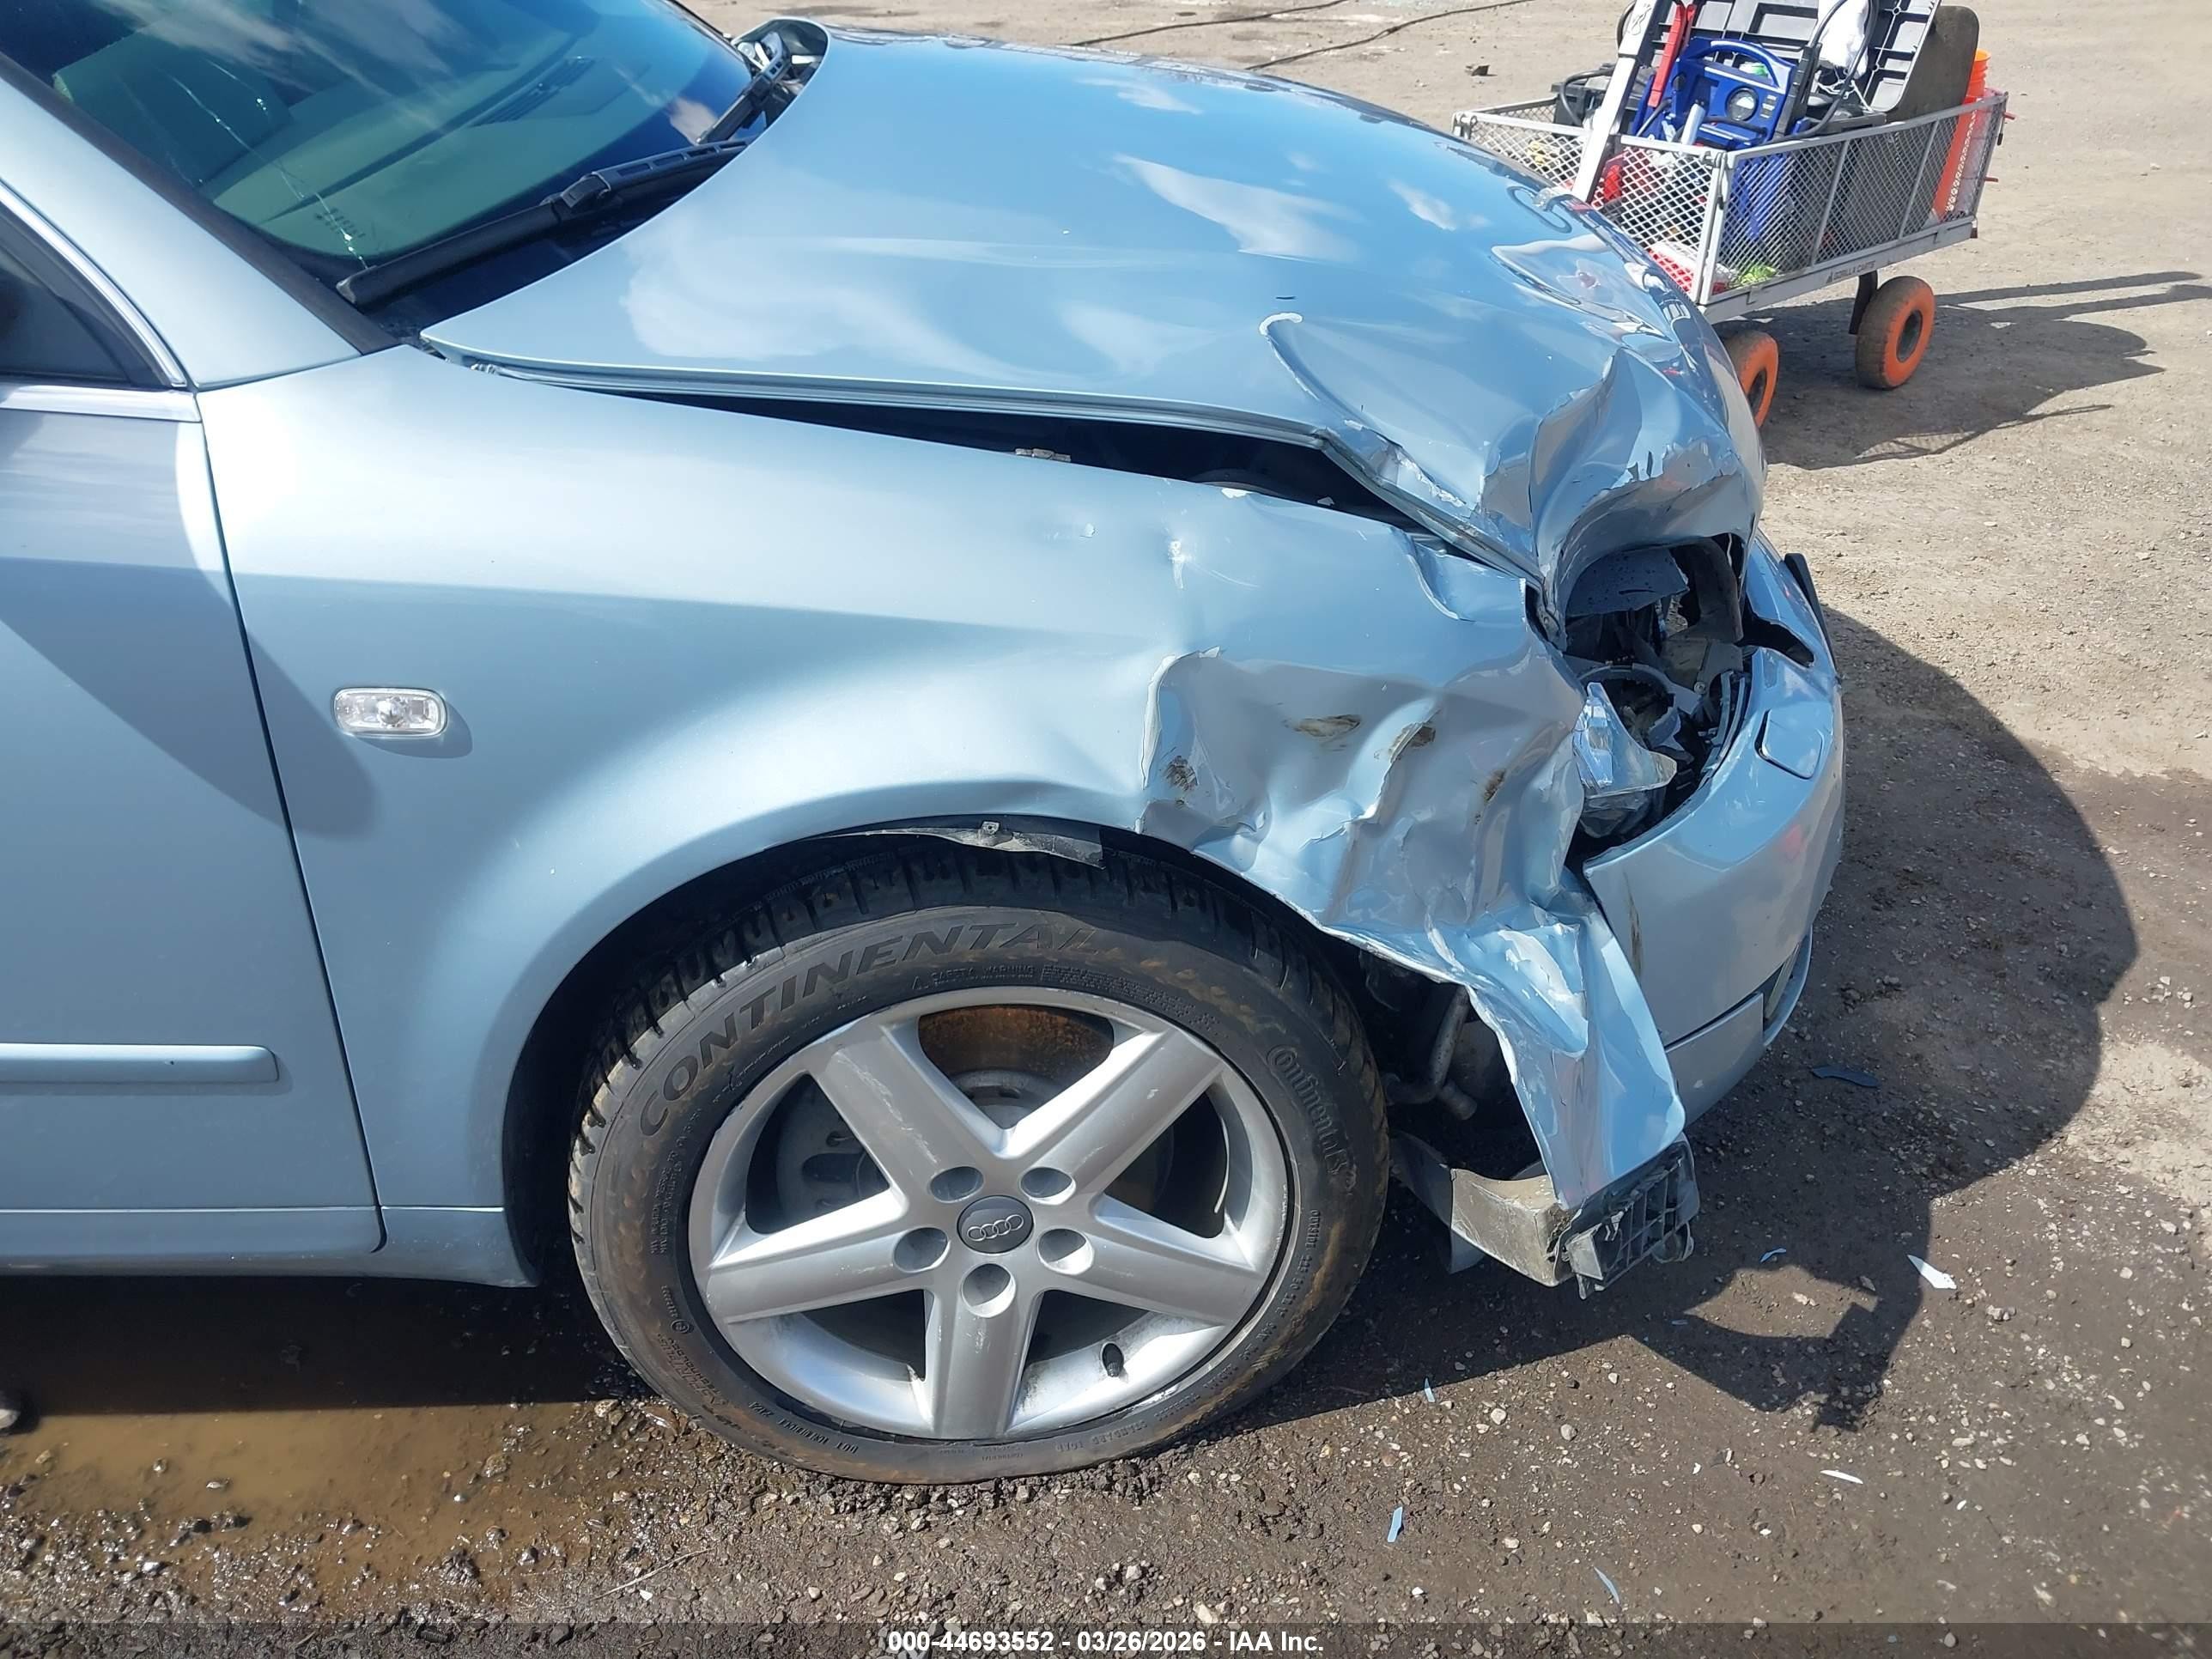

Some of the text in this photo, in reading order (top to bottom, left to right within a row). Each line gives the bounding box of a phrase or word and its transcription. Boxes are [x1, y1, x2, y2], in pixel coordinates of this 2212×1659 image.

[640, 922, 1100, 1136] CONTINENTAL
[1267, 1044, 1346, 1159] Continental
[666, 1337, 721, 1395] TECHNOLOGY
[1056, 1440, 1084, 1453] LOAD
[1091, 1421, 1149, 1445] STANDARD
